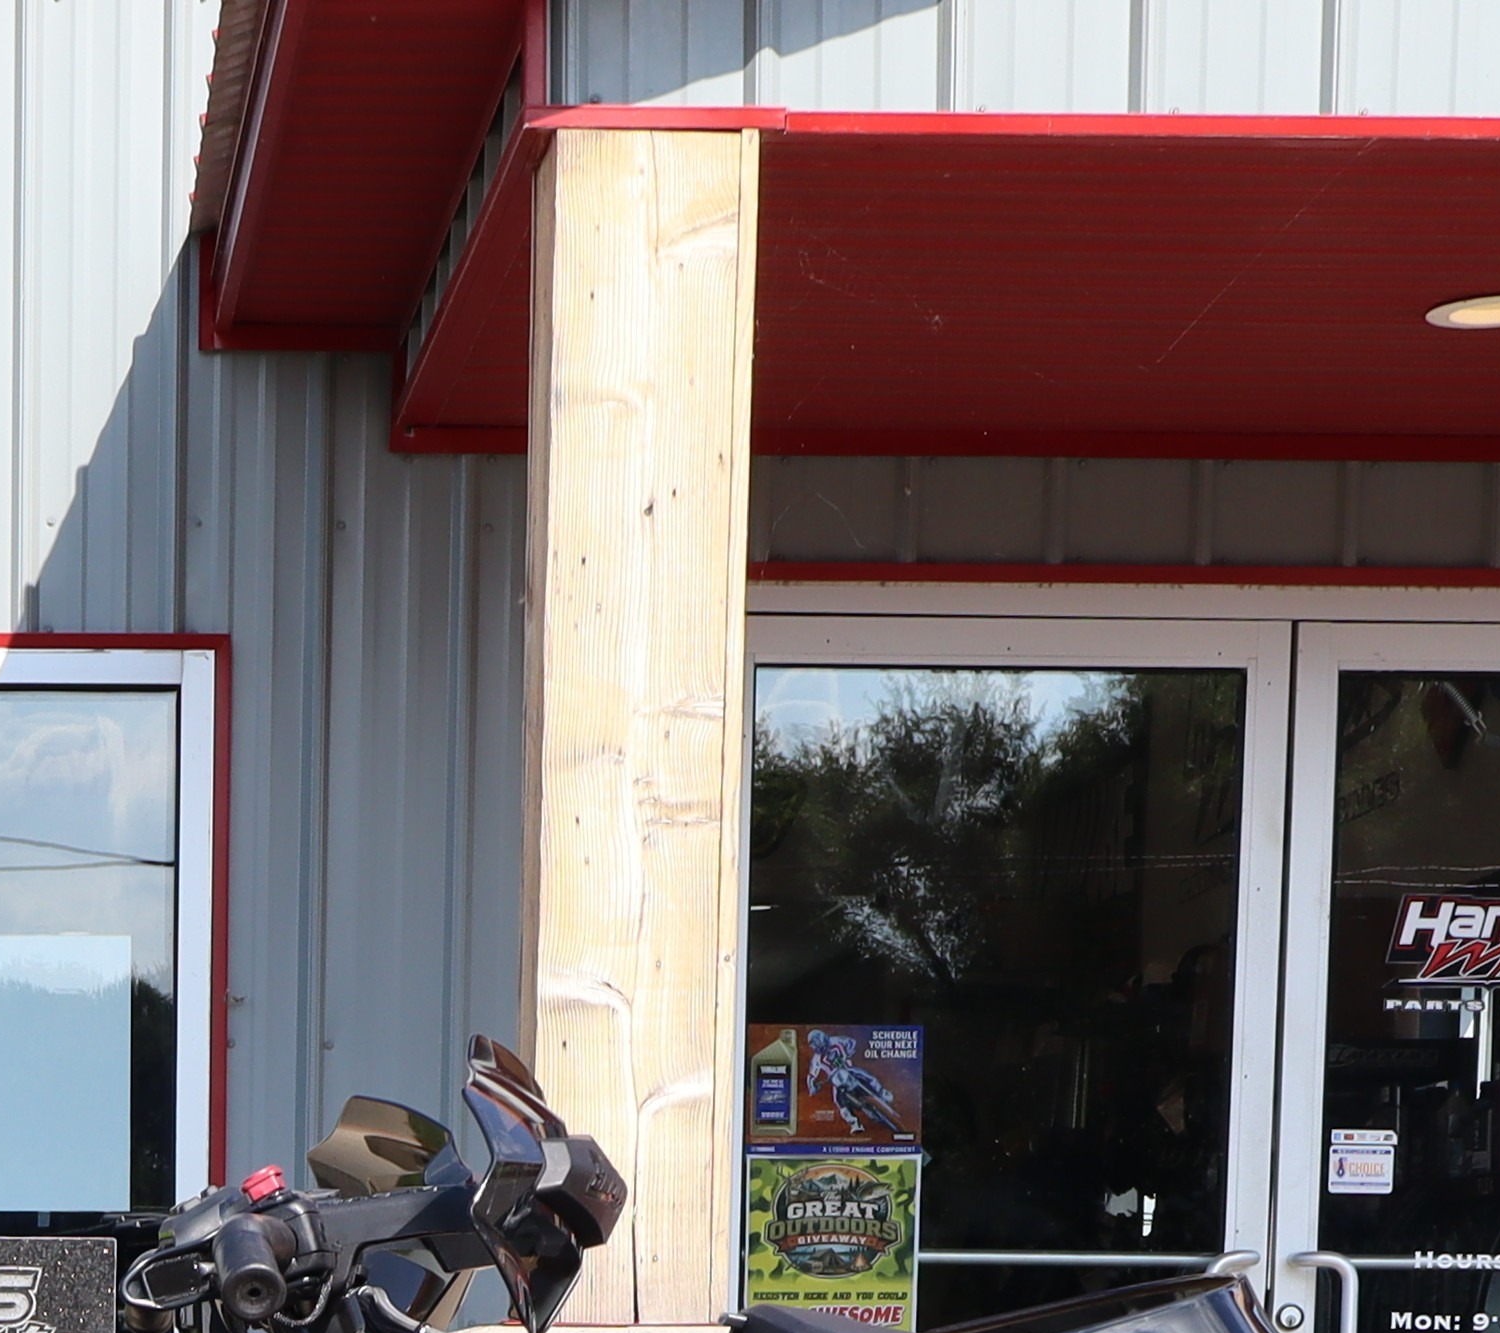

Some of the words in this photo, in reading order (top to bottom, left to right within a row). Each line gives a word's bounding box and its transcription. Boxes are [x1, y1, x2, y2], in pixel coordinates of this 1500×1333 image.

[1384, 999, 1485, 1012] PARTS
[872, 1030, 918, 1041] SCHEDULE
[869, 1040, 893, 1050] YOUR
[894, 1040, 918, 1050] NEXT
[864, 1049, 879, 1059] OIL
[880, 1049, 918, 1059] CHANGE
[786, 1200, 880, 1219] GREAT
[769, 1217, 898, 1241] OUTDOORS
[796, 1234, 868, 1245] GIVEAWAY
[831, 1291, 852, 1301] AND
[877, 1291, 908, 1301] COULD
[808, 1305, 905, 1324] ESOME
[1390, 1311, 1461, 1331] MON:
